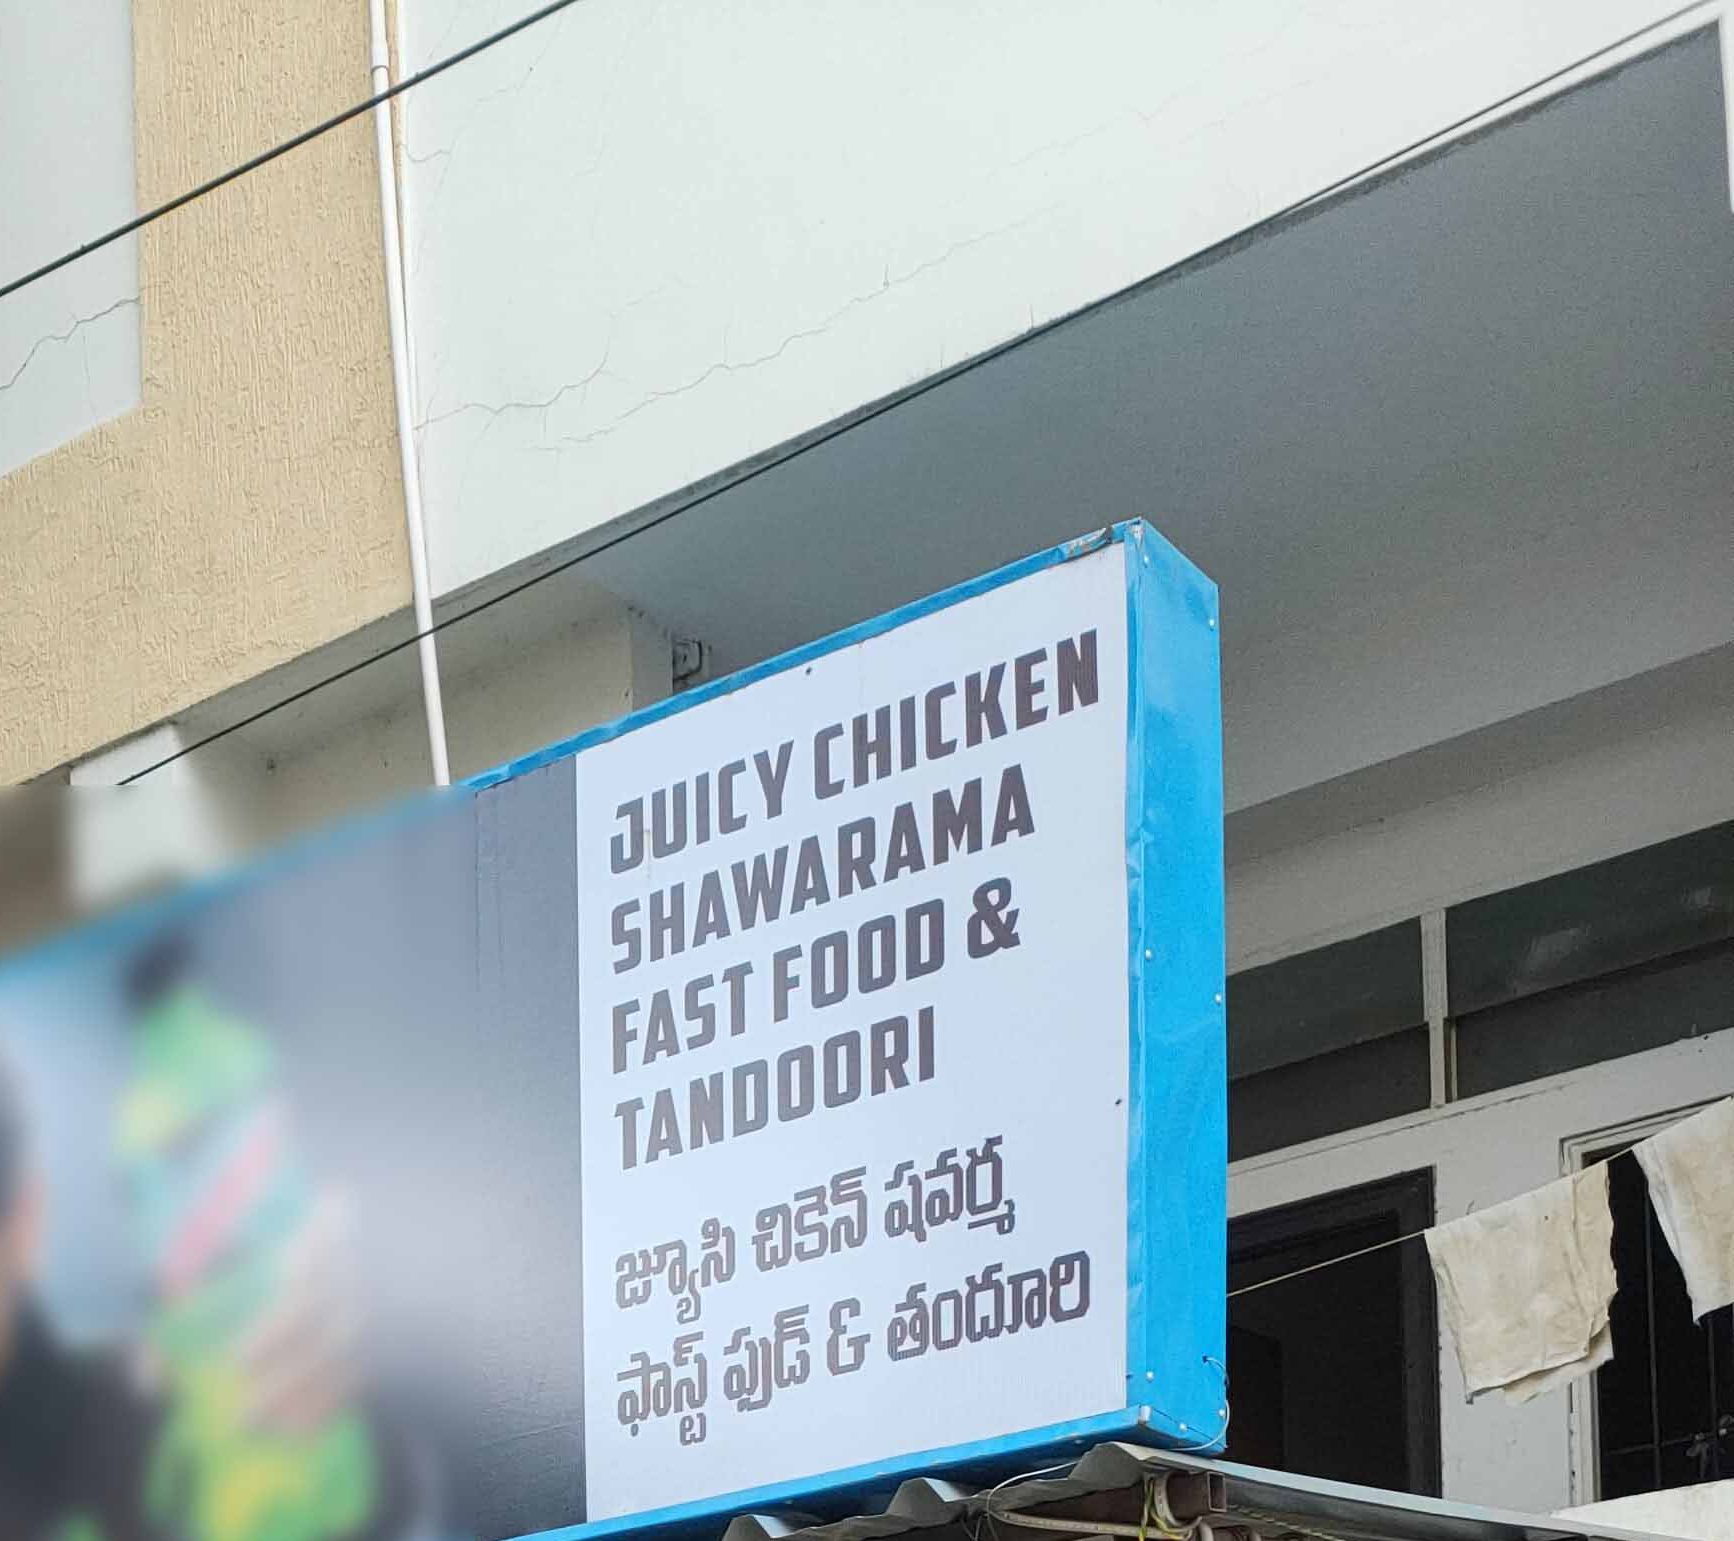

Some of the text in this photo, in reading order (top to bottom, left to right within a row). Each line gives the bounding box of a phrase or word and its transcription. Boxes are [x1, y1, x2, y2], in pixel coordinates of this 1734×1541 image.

[610, 627, 1099, 874] JUICY CHICKEN
[610, 762, 1035, 974] SHAWARAMA
[612, 877, 1020, 1073] FAST FOOD &
[614, 1006, 935, 1170] TANDOORI
[752, 1166, 867, 1272] చికెన్
[884, 1134, 1015, 1242] షవర్మ
[617, 1331, 707, 1446] ఫాస్ట్
[826, 1297, 871, 1377] &
[887, 1250, 1091, 1362] తందూరి
